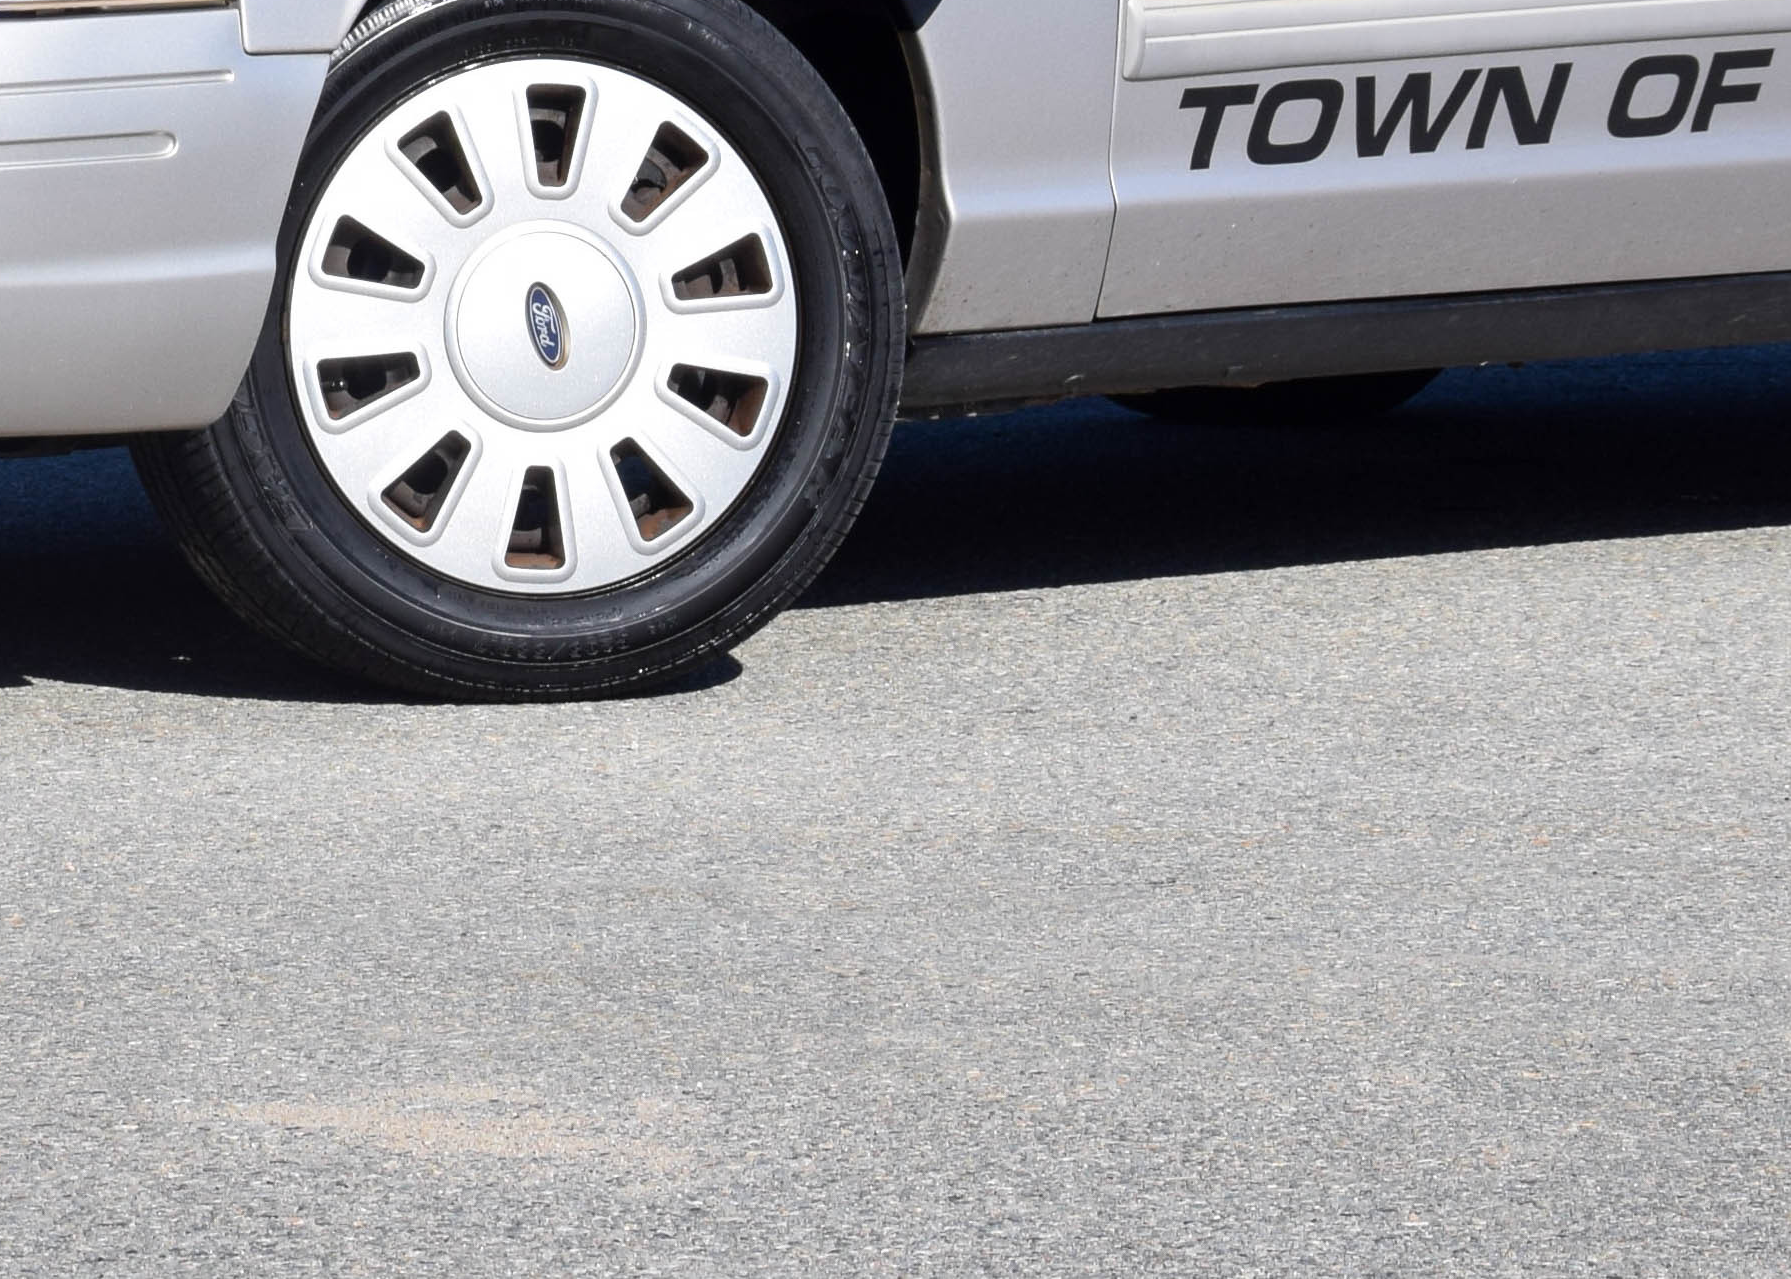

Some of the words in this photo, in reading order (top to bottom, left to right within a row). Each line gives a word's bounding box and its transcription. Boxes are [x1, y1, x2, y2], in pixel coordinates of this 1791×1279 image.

[1177, 61, 1574, 172] TOWN
[1607, 46, 1777, 141] OF
[532, 302, 556, 348] Ford
